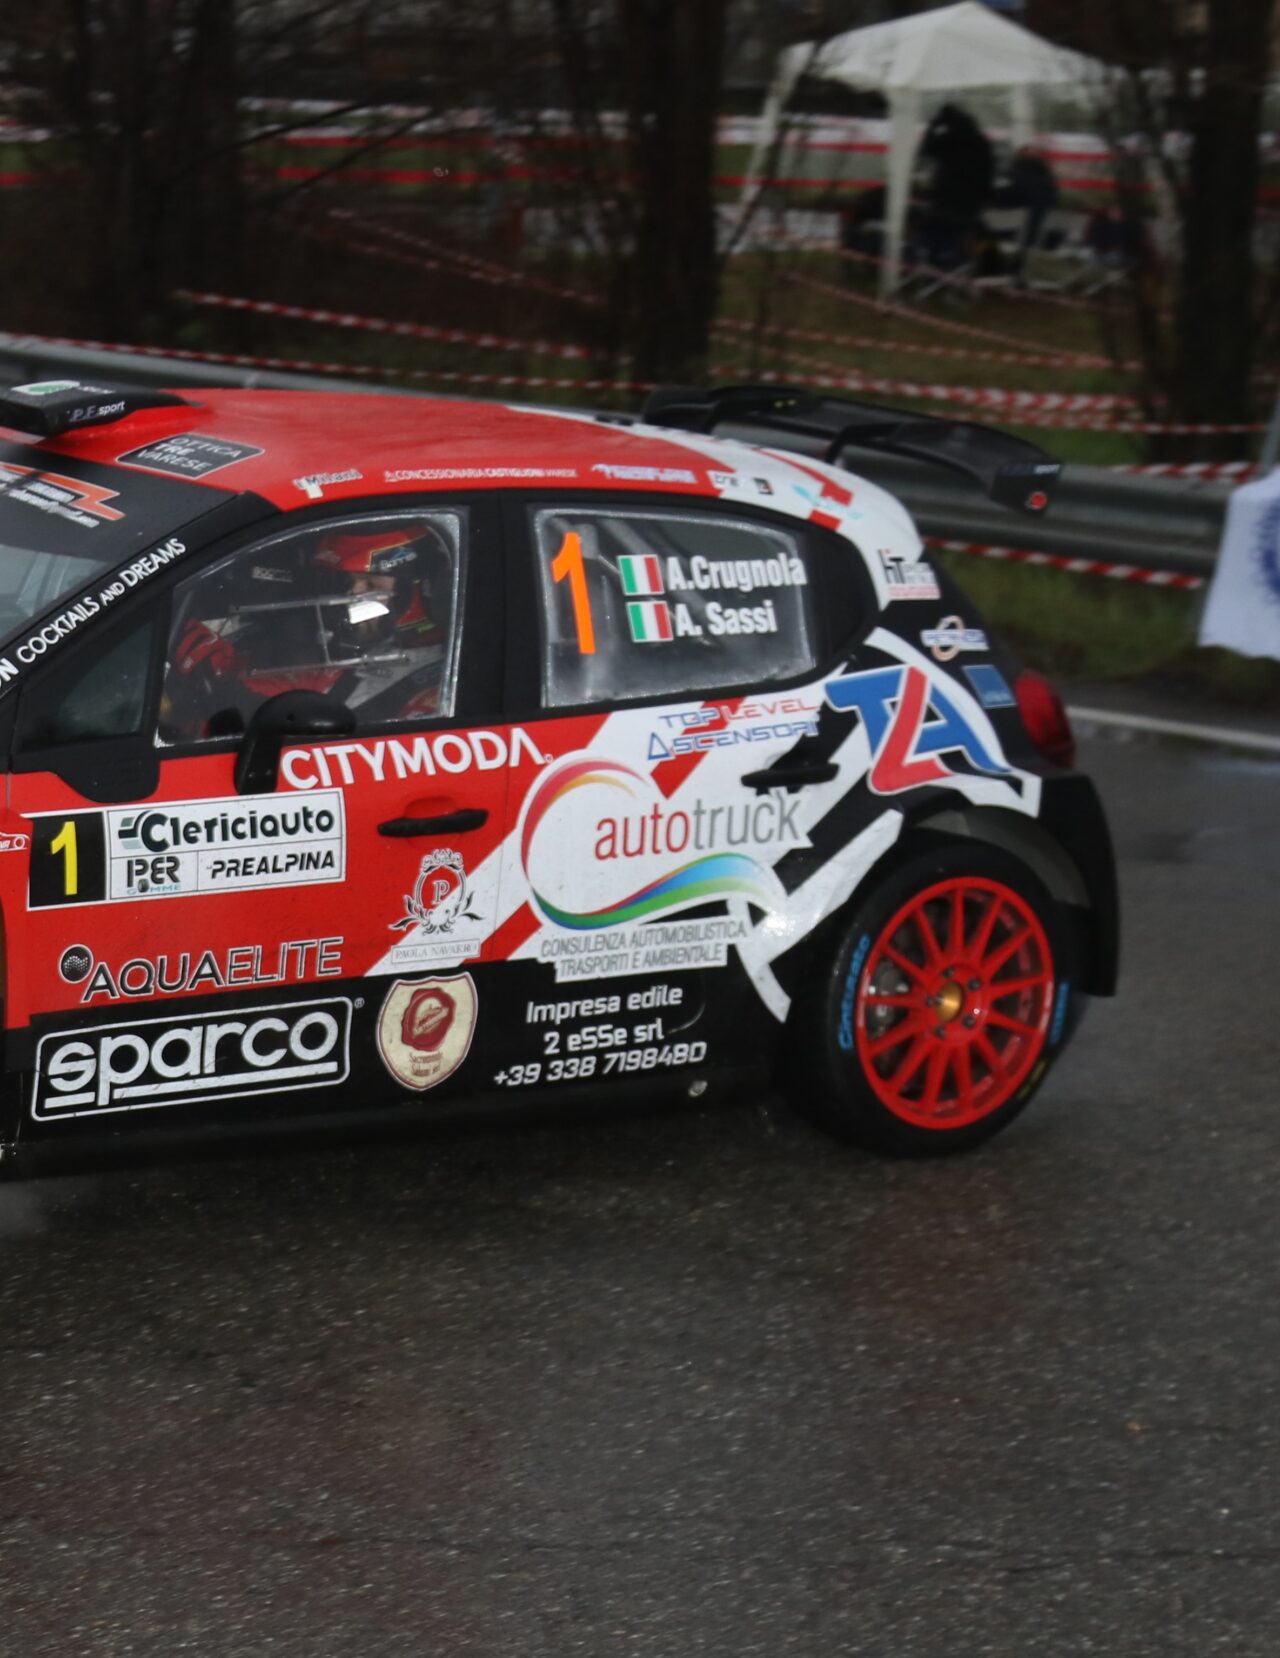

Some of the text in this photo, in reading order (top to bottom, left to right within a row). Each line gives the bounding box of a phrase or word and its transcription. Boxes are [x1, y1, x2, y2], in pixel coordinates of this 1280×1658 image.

[137, 449, 213, 471] VARESE
[551, 531, 596, 655] 1
[666, 551, 808, 593] A.Crugnola
[16, 595, 101, 665] COCKTAILS
[99, 581, 126, 606] AND
[118, 537, 188, 589] DREAMS
[674, 599, 778, 637] A. Sassi
[720, 698, 819, 721] LEVEL
[280, 728, 546, 789] CITYMODA
[139, 805, 334, 852] Clericiauto
[593, 794, 800, 862] autotruck
[51, 820, 78, 895] 1
[211, 850, 335, 880] PREALPINA
[432, 879, 450, 905] P
[541, 920, 748, 958] CONSULENZA AUTOMOBILISTICA
[81, 936, 345, 1003] AQUAELITE
[559, 944, 723, 978] TRASPORTI E AMBIENTALE
[526, 985, 684, 1025] Impresa edile
[544, 1017, 665, 1055] 2 eSSe srl
[48, 1010, 339, 1107] sparco
[493, 1041, 707, 1086] +39 338 7198480
